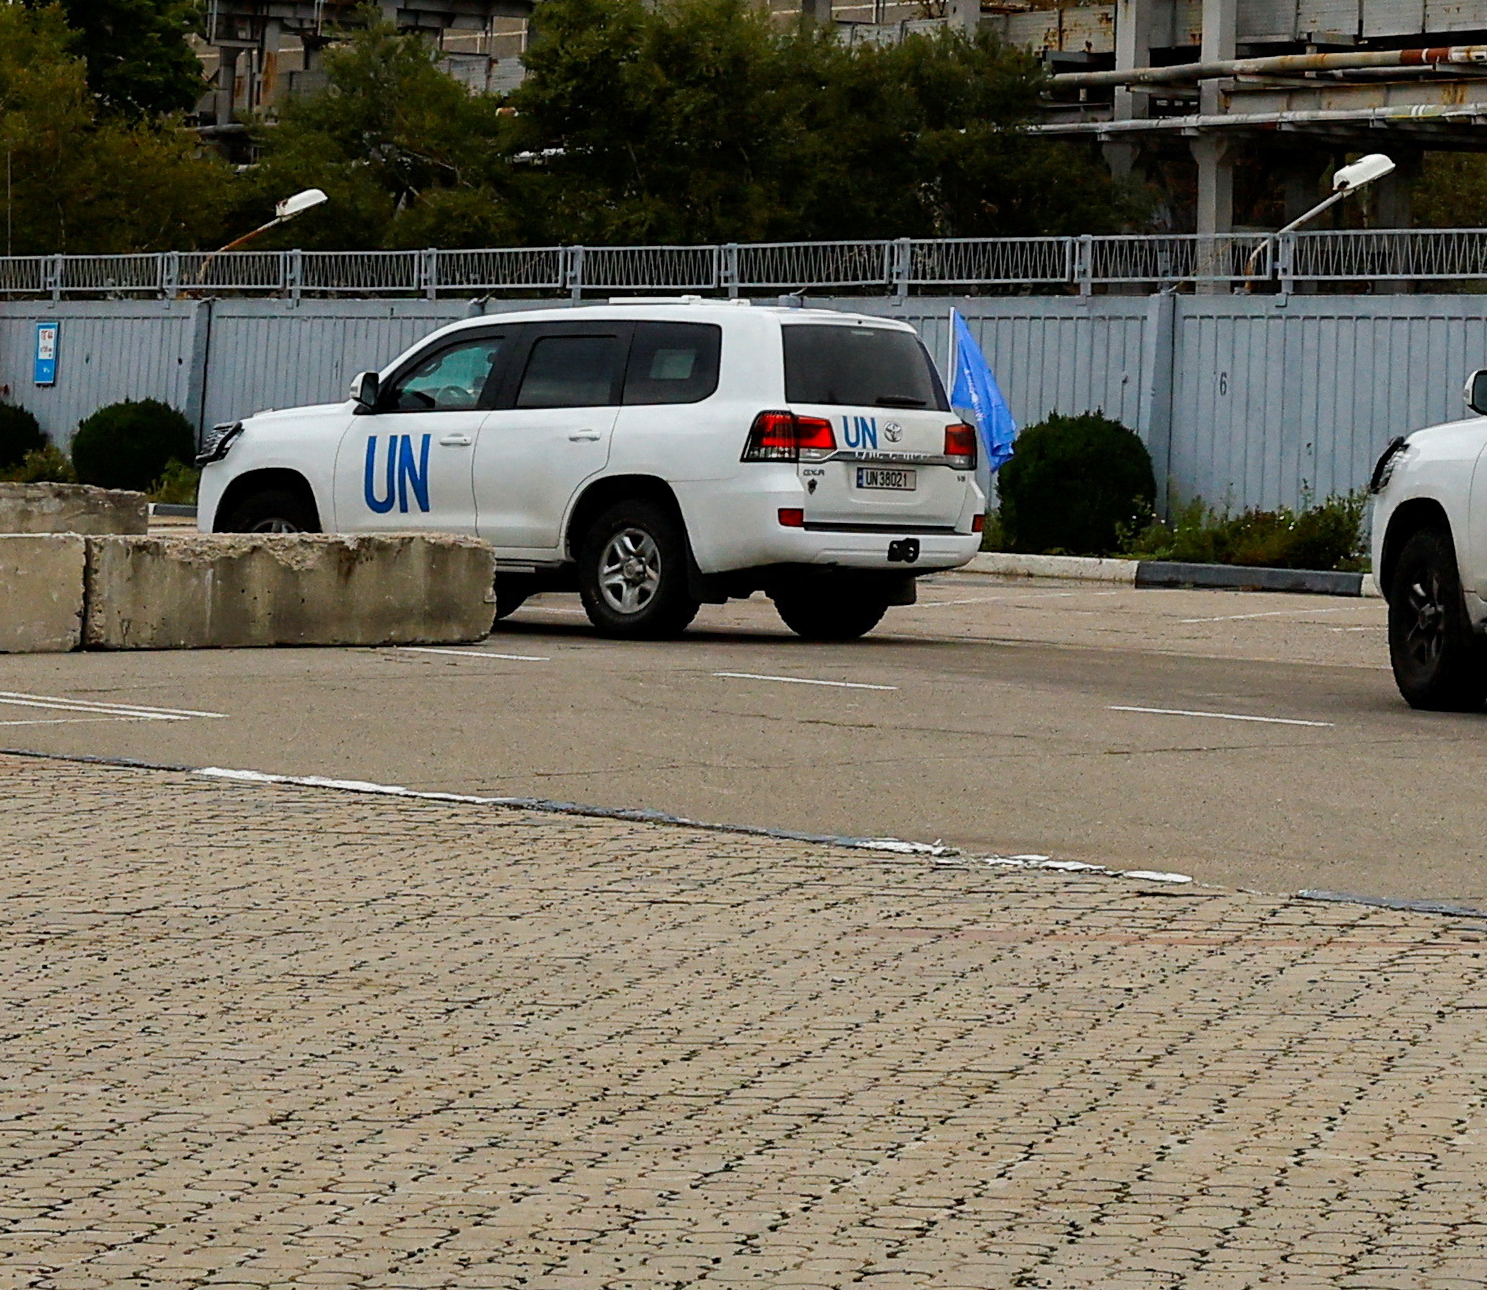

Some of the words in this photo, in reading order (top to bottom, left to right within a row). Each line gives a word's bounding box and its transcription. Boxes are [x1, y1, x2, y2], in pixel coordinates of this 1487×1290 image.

[1220, 372, 1228, 396] 6
[842, 415, 878, 450] UN
[364, 433, 431, 514] UN
[866, 471, 878, 486] UN
[879, 471, 907, 487] 38021
